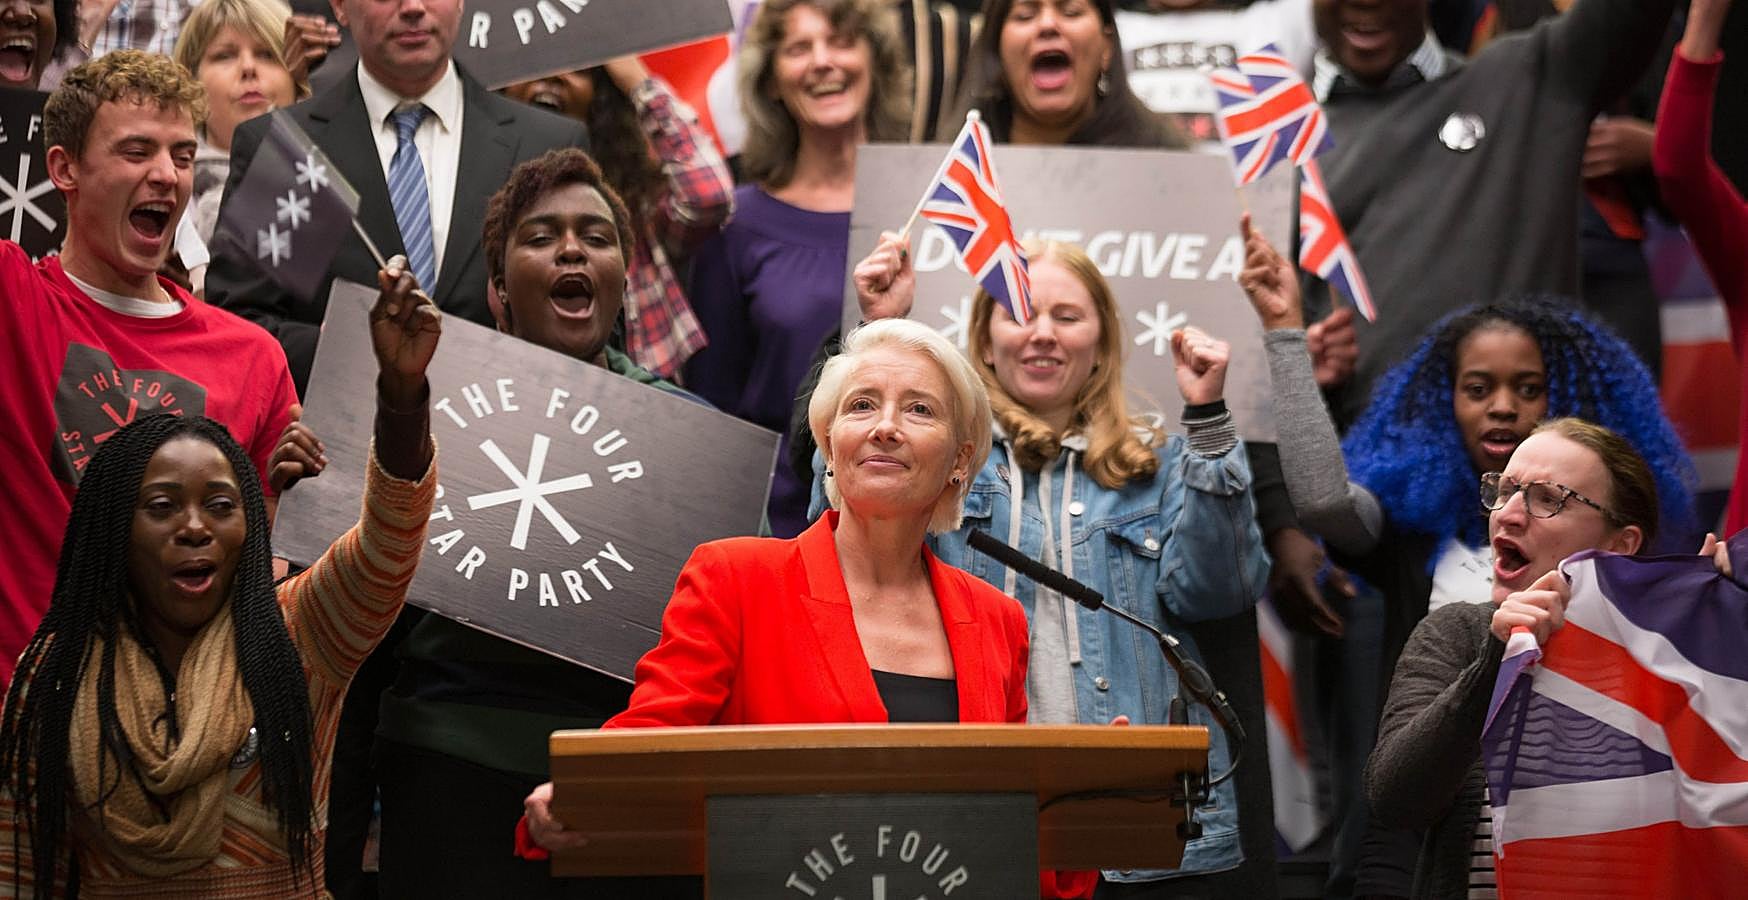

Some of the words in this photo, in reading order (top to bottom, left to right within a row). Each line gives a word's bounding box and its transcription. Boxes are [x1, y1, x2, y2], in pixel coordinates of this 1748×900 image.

[1087, 230, 1207, 280] GIVE
[1206, 235, 1246, 282] A
[78, 369, 123, 399] THE
[61, 431, 91, 471] STA
[434, 378, 520, 429] THE
[546, 387, 644, 483] FOUR
[508, 541, 634, 607] PARTY
[785, 832, 855, 897] THE
[877, 824, 968, 896] FOUR
